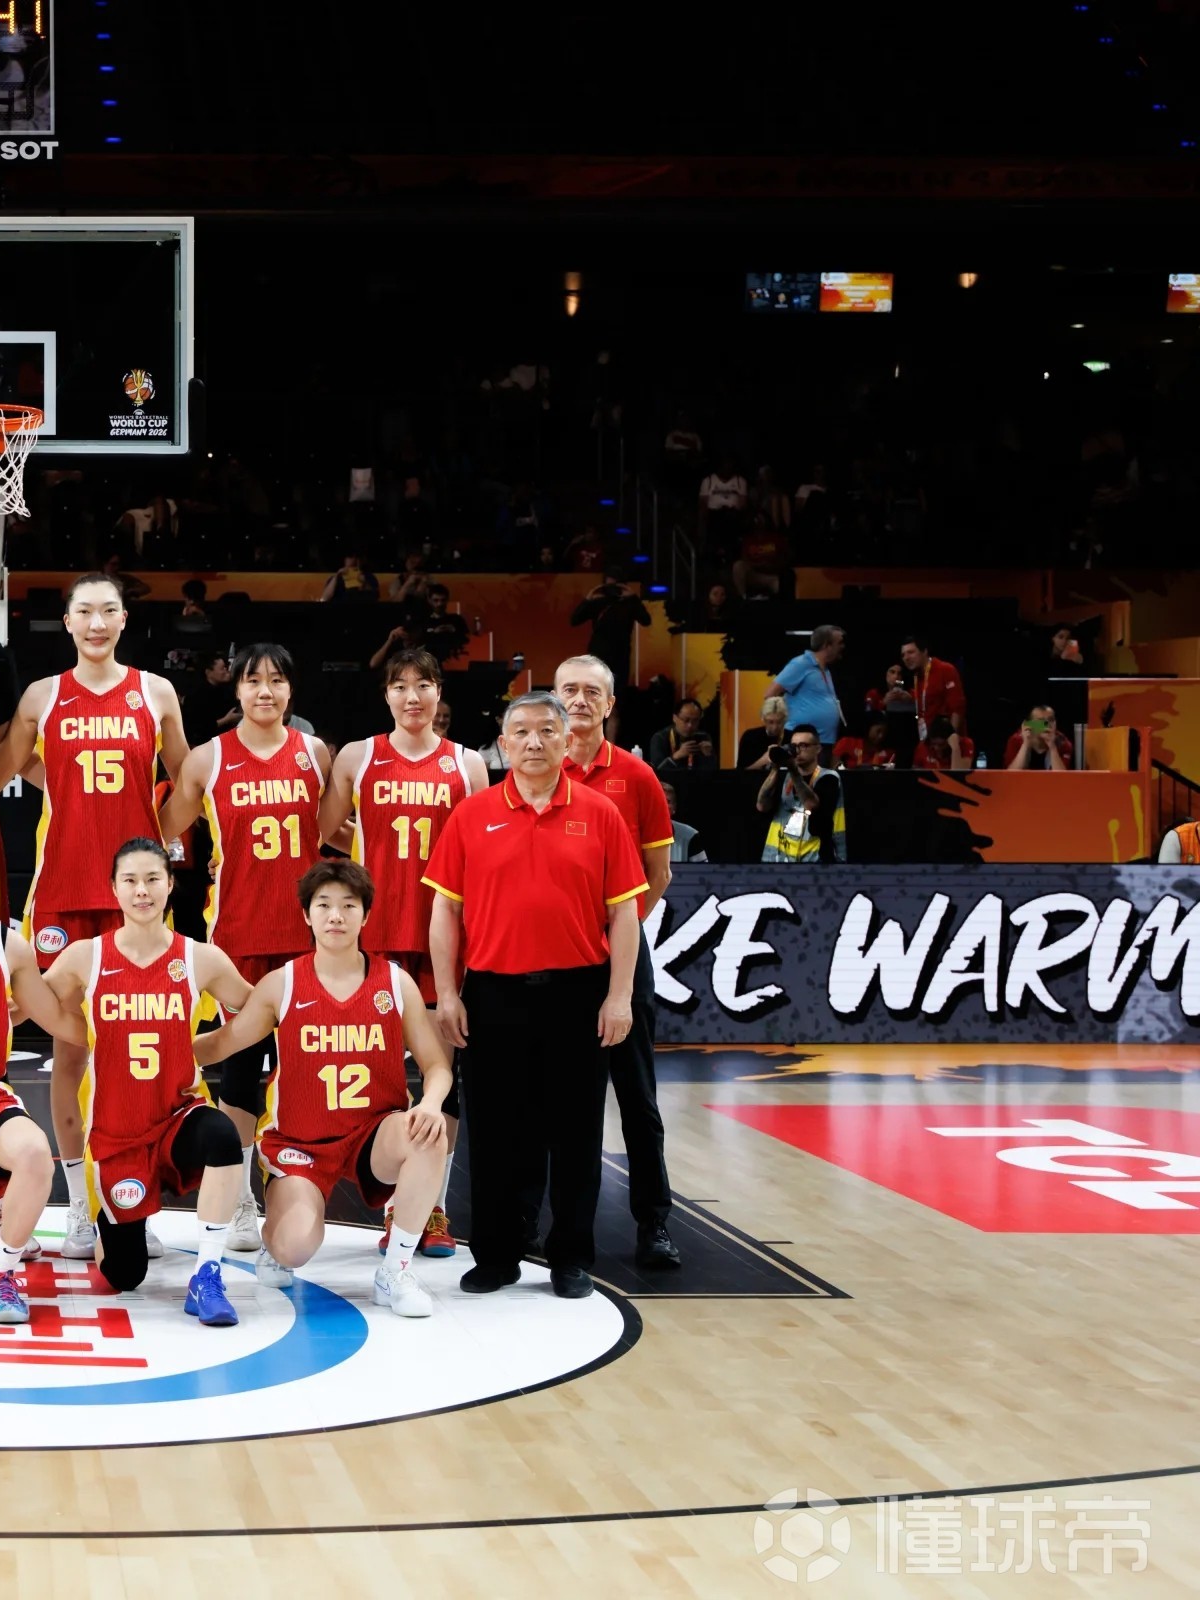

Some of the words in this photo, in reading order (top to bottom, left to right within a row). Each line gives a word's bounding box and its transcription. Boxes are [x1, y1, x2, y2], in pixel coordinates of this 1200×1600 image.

[110, 428, 147, 436] GERMANY
[148, 428, 168, 436] 2026
[60, 716, 140, 741] CHINA
[75, 750, 125, 794] 15
[230, 778, 311, 807] CHINA
[373, 780, 451, 809] CHINA
[251, 814, 301, 860] 31
[391, 815, 432, 861] 11
[40, 933, 63, 946] 伊利
[829, 892, 1200, 1016] WARM
[100, 992, 186, 1021] CHINA
[300, 1023, 386, 1053] CHINA
[128, 1032, 160, 1080] 5
[317, 1063, 371, 1111] 12
[114, 1187, 139, 1199] 伊利
